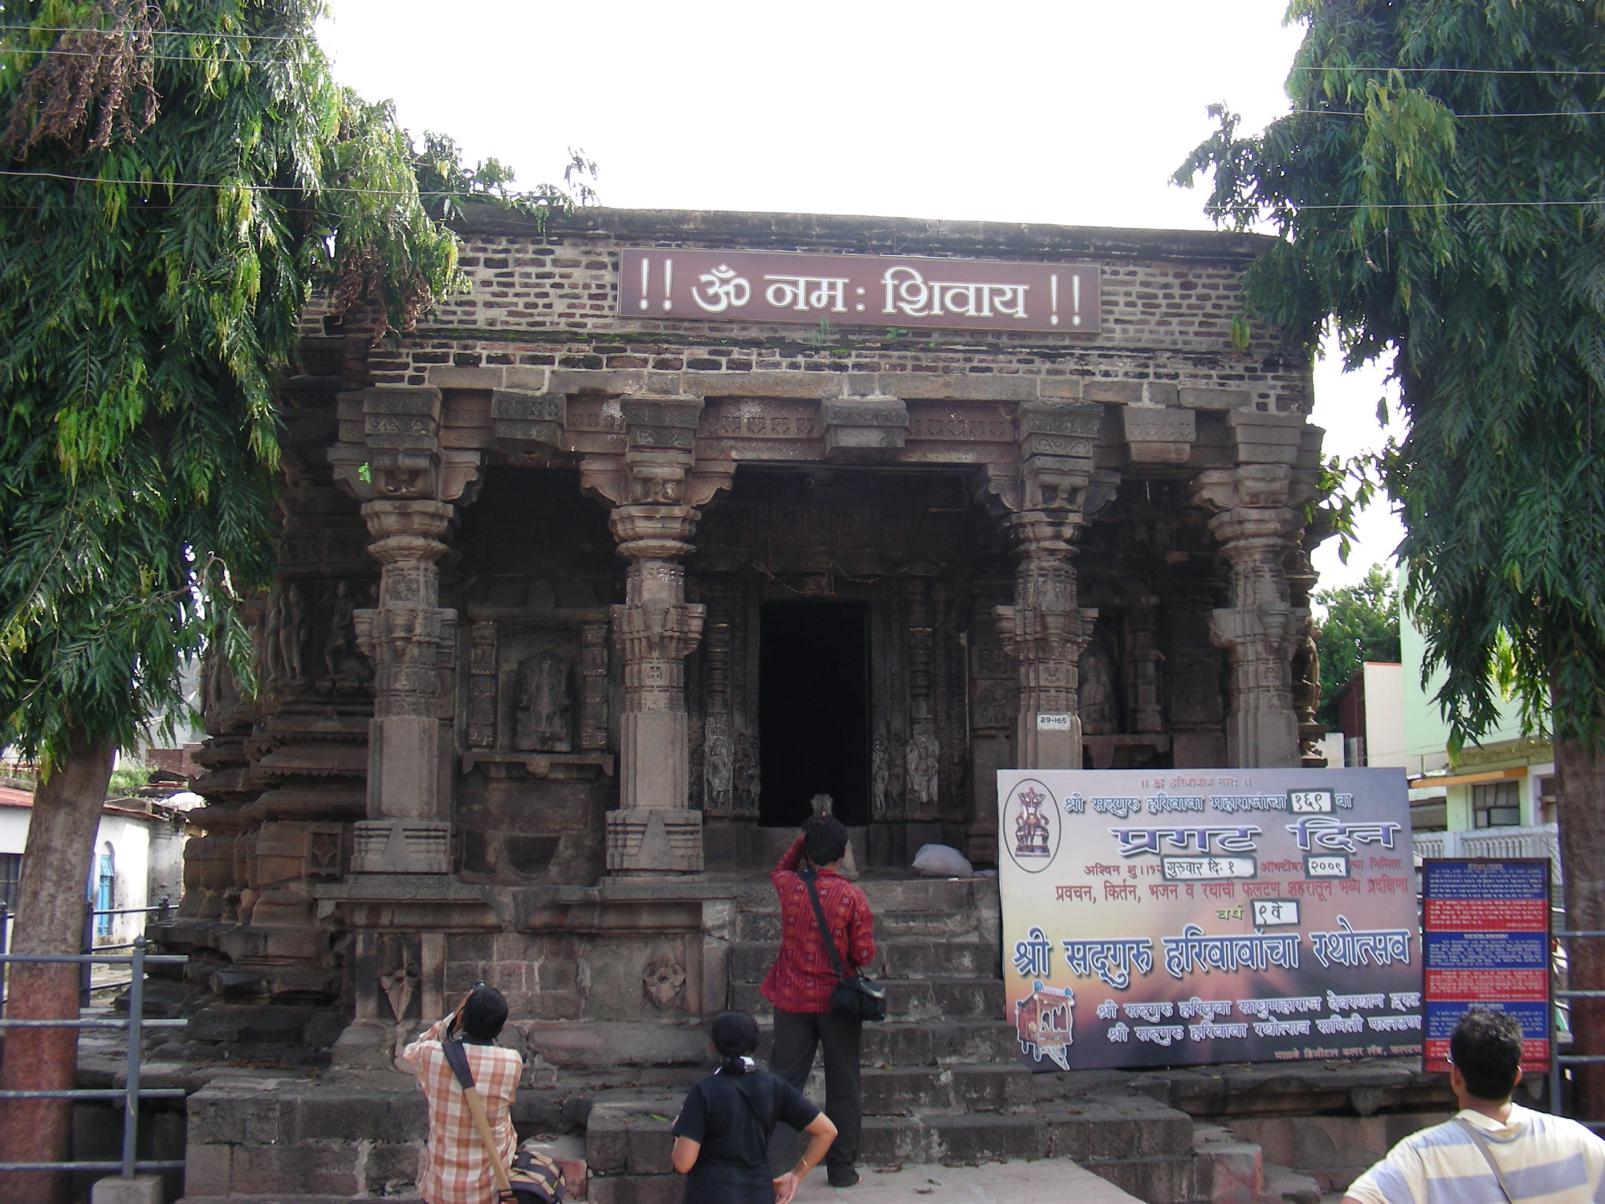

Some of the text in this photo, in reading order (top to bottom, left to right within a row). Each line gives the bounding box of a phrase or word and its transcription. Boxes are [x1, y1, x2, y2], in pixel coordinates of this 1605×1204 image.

[691, 264, 750, 312] ॐ
[880, 266, 1030, 317] शिवाय
[1064, 792, 1086, 813] श्री
[1295, 792, 1323, 812] १६९
[1108, 815, 1401, 856] प्रगट दिन
[1311, 860, 1343, 873] २००९
[1149, 883, 1179, 900] भजन
[1185, 883, 1195, 899] व
[1202, 879, 1235, 899] रथाची
[1242, 880, 1281, 899] फलटण
[1288, 878, 1332, 901] शहरातून
[1012, 925, 1052, 976] श्री
[1161, 923, 1301, 977] हरिबाबांचा
[1309, 915, 1411, 968] रथोत्सव
[1096, 999, 1119, 1019] श्री
[1326, 989, 1385, 1013] देवस्थान
[1107, 1021, 1129, 1042] श्री
[1253, 1015, 1311, 1037] रथोत्सव
[1315, 1012, 1364, 1035] समिती
[1367, 1014, 1423, 1032] फलटण
